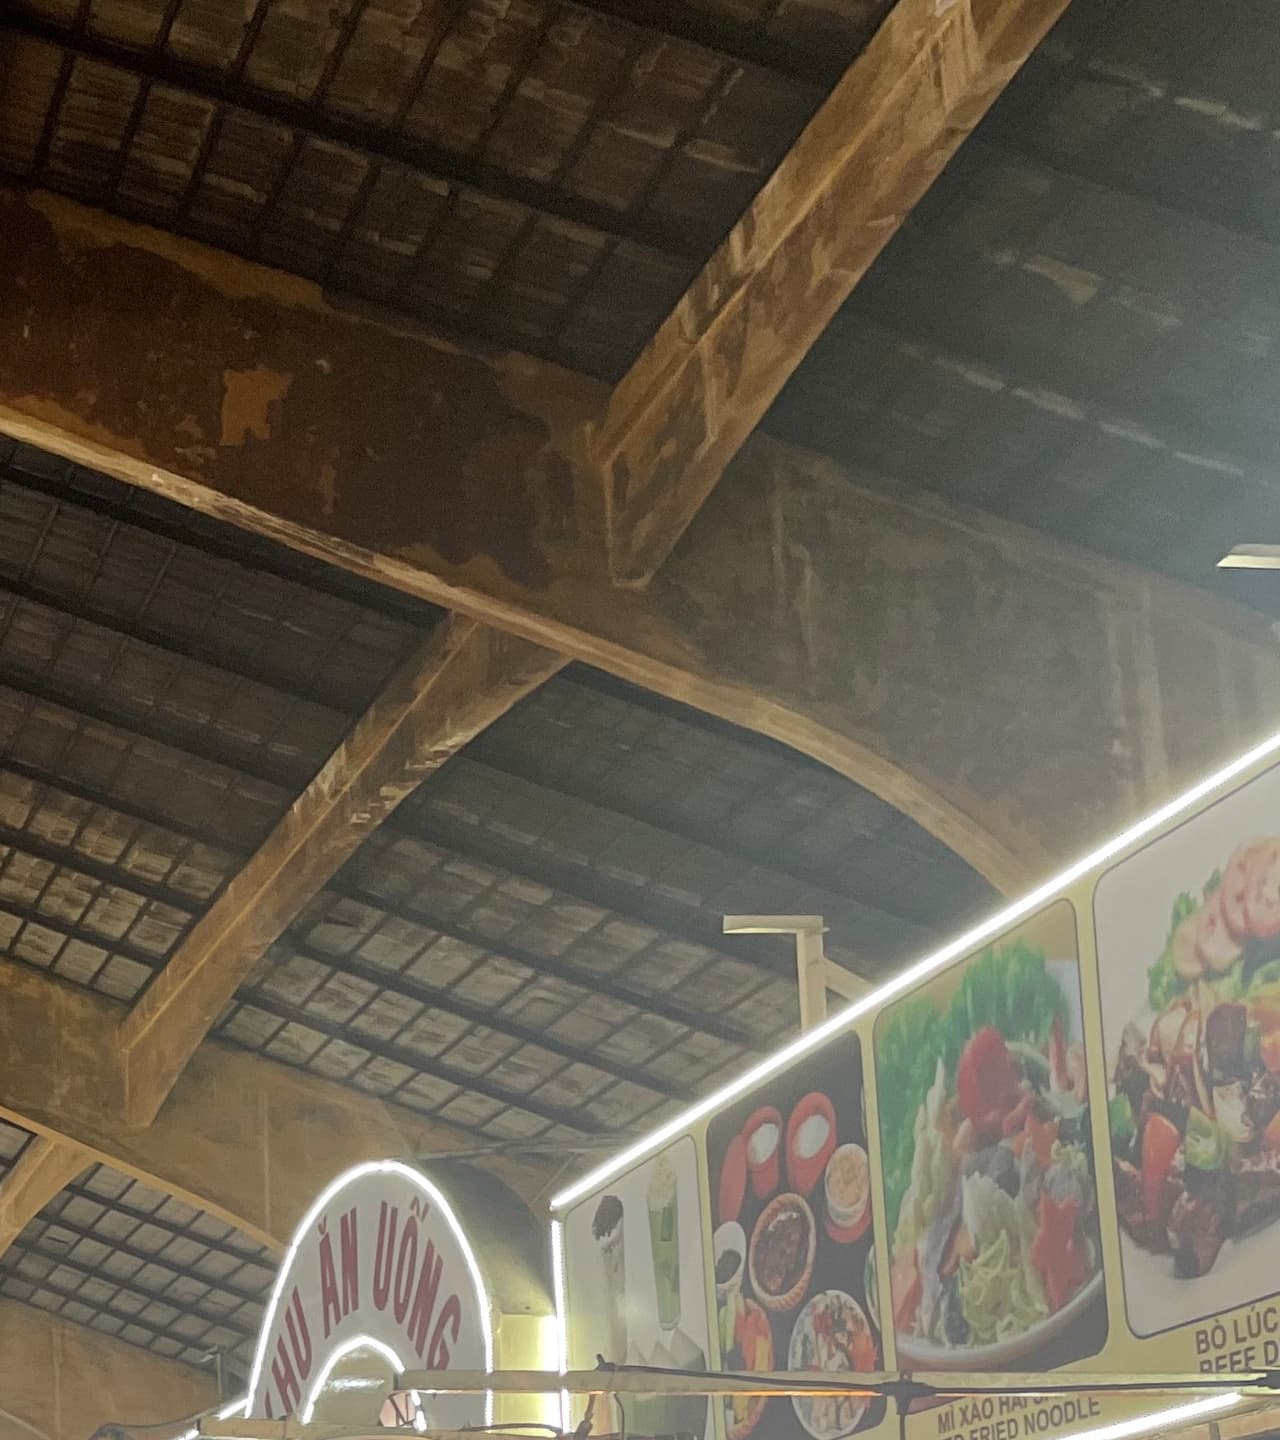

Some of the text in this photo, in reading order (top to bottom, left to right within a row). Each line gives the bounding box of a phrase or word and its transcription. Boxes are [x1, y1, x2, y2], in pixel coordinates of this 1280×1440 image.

[317, 1206, 359, 1339] ĂN
[1196, 1318, 1226, 1354] BÒ
[1023, 1398, 1101, 1436] NOODLE
